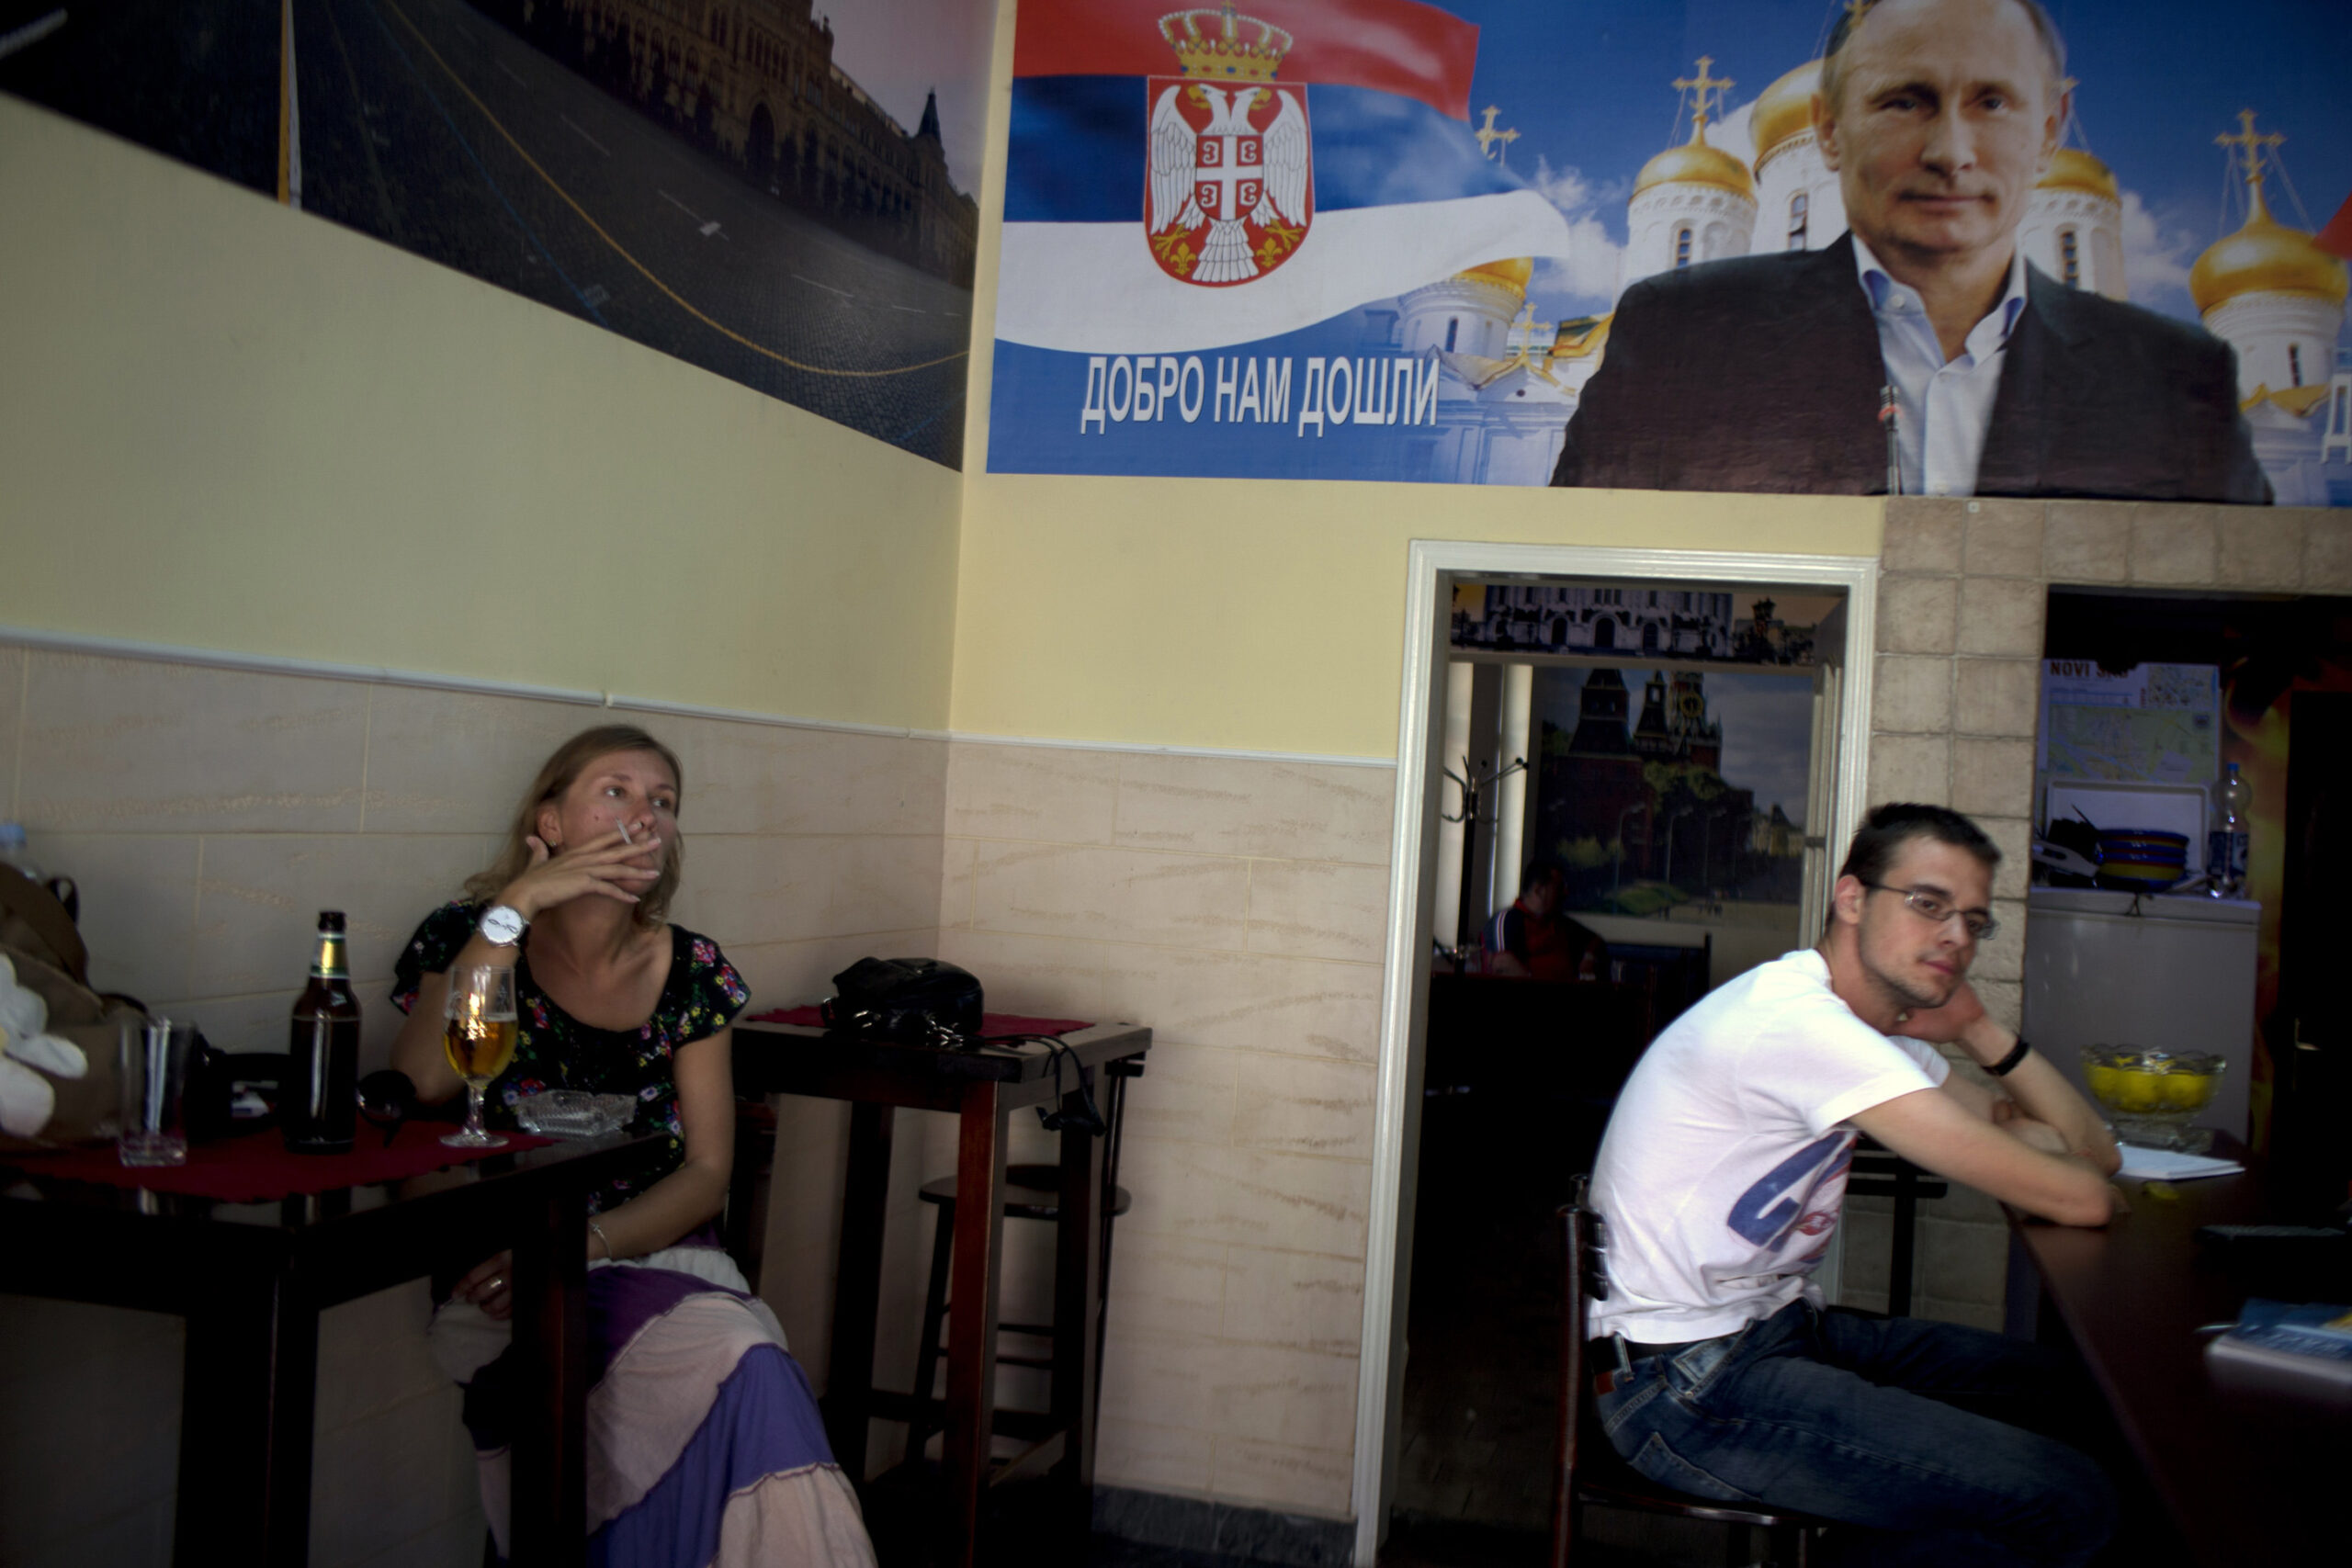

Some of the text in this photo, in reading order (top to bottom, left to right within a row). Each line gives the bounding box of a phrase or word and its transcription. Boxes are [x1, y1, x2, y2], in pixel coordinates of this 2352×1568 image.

[1080, 355, 1440, 437] ДОБРО НАМ ДОШЛИ
[2050, 660, 2089, 677] NOVI
